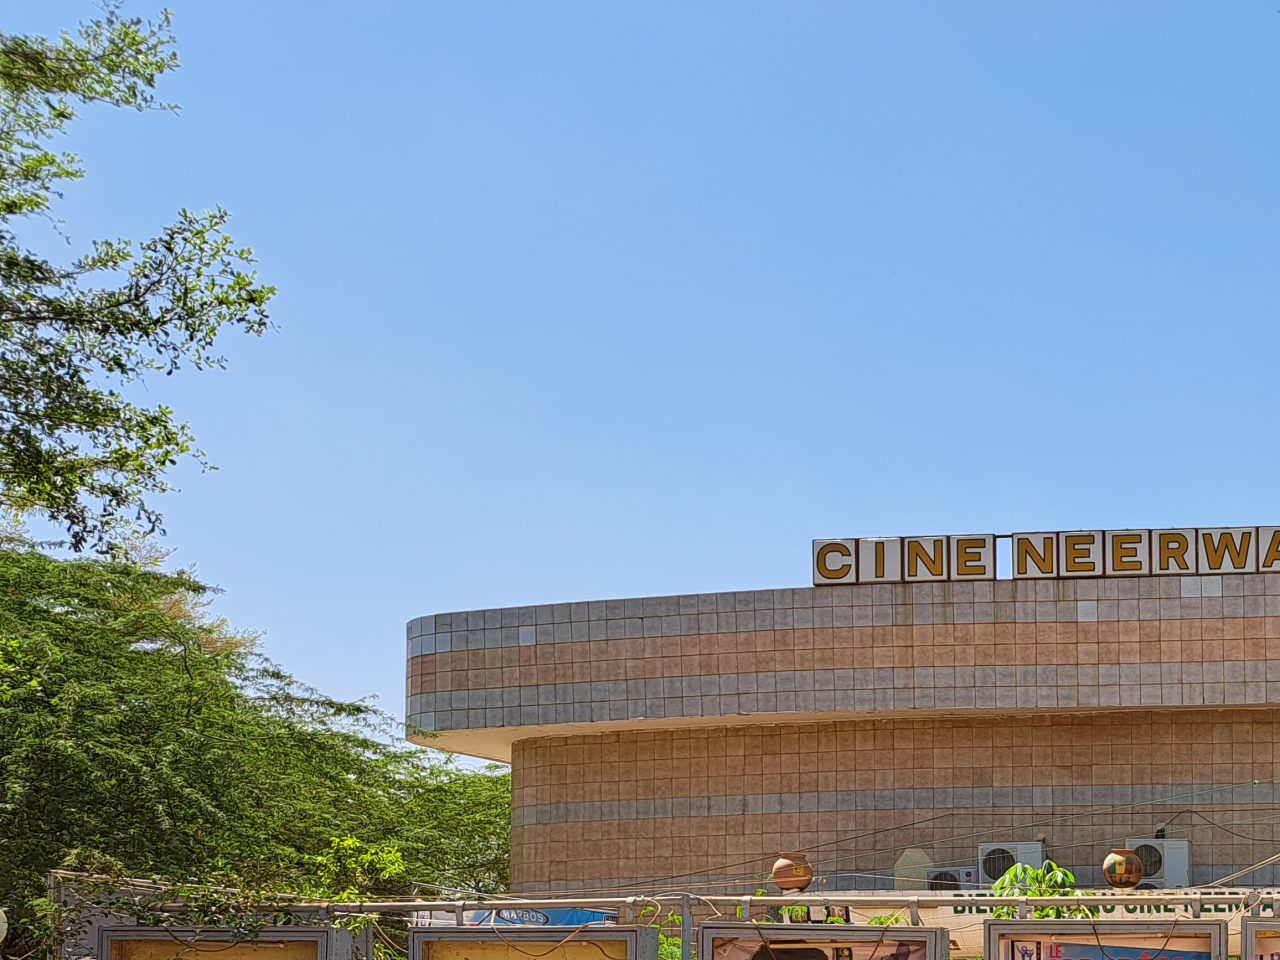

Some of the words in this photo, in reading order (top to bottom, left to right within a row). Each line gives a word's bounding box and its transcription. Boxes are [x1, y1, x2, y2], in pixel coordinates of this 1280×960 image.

[815, 538, 987, 580] CINE
[502, 909, 545, 924] MARBOS
[1049, 944, 1062, 958] LE
